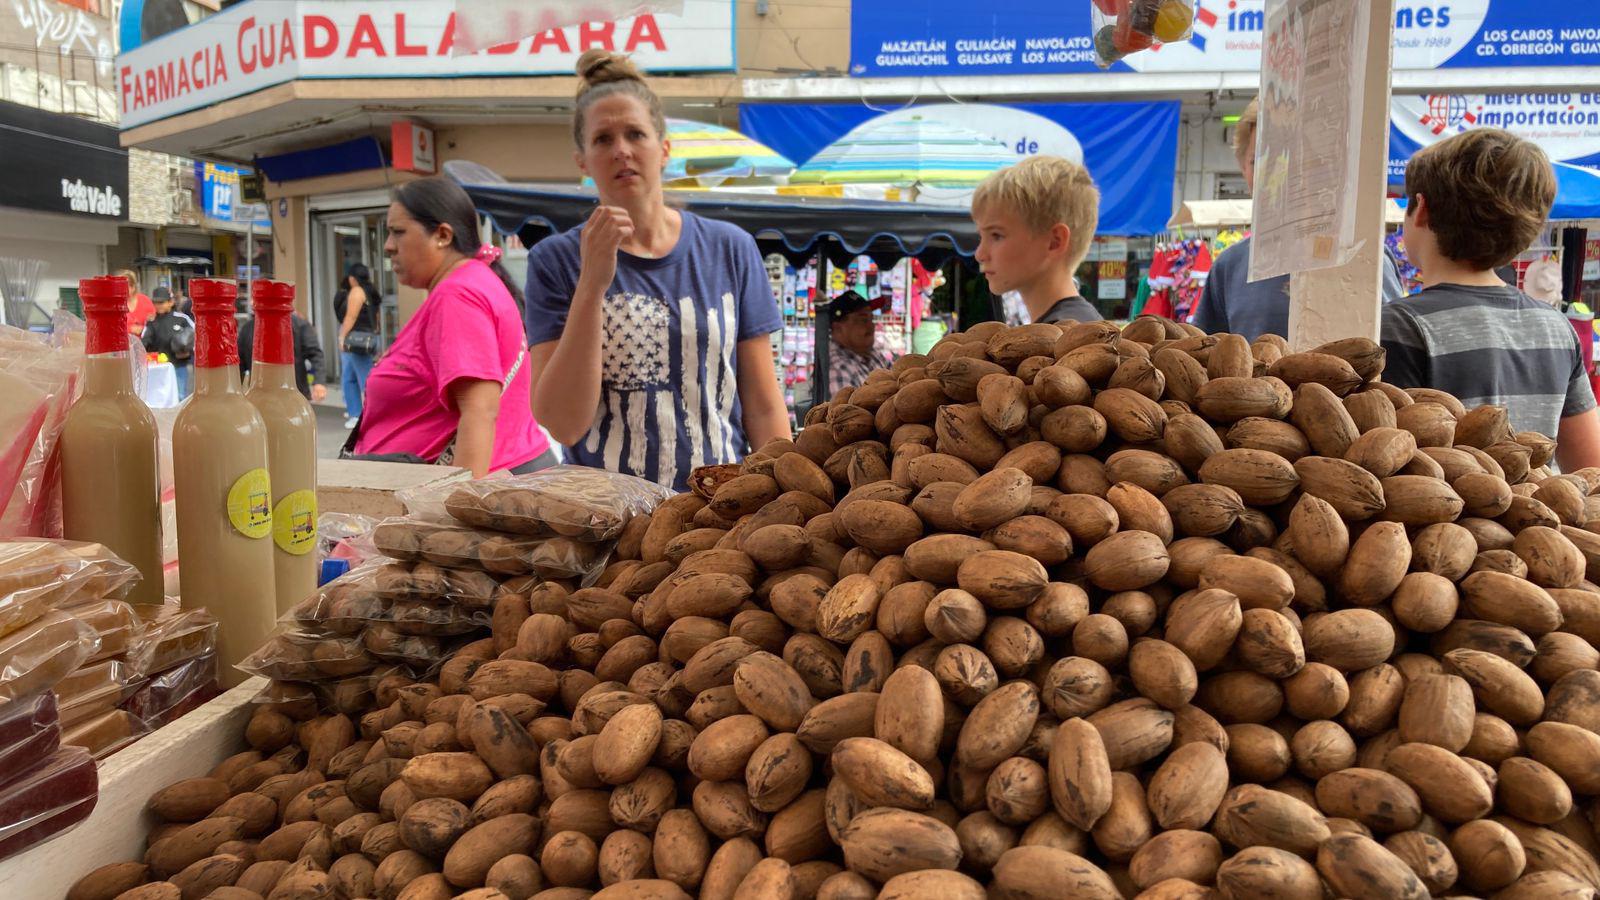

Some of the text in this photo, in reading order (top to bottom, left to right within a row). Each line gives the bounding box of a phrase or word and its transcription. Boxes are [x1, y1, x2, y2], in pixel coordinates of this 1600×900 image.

[1395, 7, 1451, 28] nes
[881, 36, 1091, 52] MAZATLÁN CULIACÁN NAVOLATO
[1484, 29, 1508, 42] LOS
[1511, 29, 1553, 42] CABOS
[1476, 43, 1498, 56] CD.
[1501, 40, 1564, 55] OBREGÓN
[120, 12, 667, 114] FARMACIA GUADALAARA
[876, 49, 1095, 66] GUAMÚCHIL GUASAVE LOS MOCHIS
[1016, 136, 1039, 154] de
[61, 178, 87, 198] Todo
[70, 197, 88, 212] con
[87, 186, 121, 216] Vale
